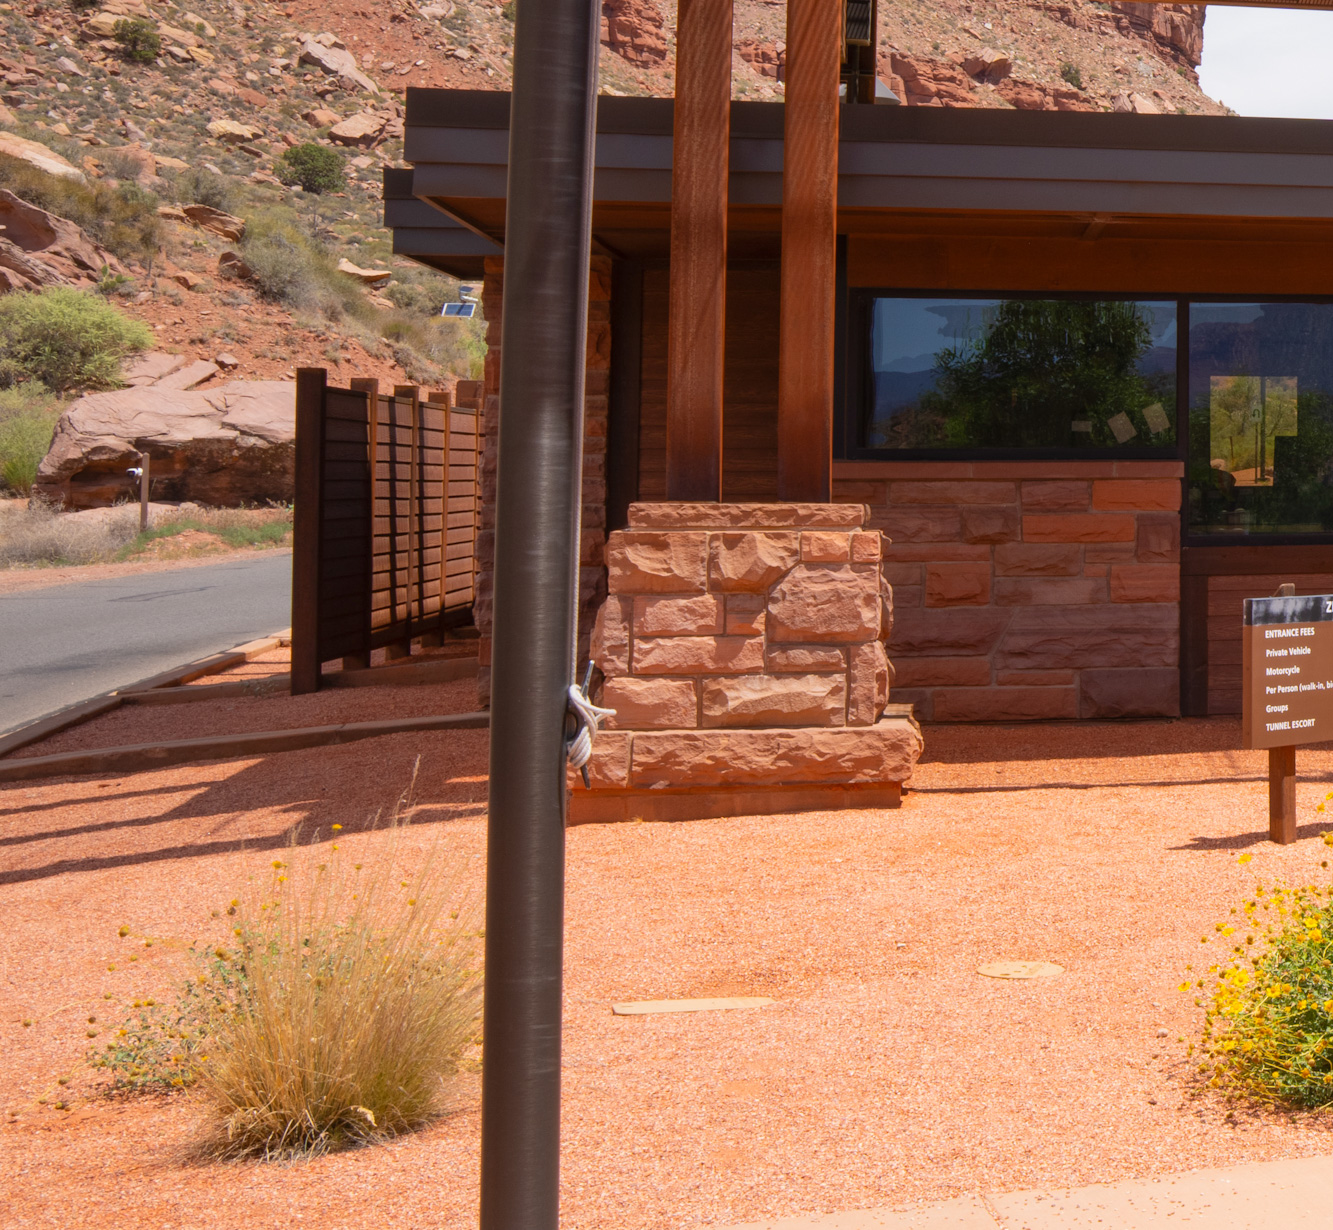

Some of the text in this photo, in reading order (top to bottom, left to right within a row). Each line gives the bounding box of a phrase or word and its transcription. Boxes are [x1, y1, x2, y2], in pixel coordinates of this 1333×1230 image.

[1265, 627, 1315, 639] ENTRANCE FEES
[1266, 646, 1311, 657] Private Vehicle
[1266, 665, 1300, 676] Motorcycle
[1266, 686, 1276, 695] Per
[1277, 684, 1298, 694] Person
[1299, 680, 1326, 693] (walk-in,
[1266, 704, 1289, 714] Groups
[1266, 718, 1316, 731] TUNNEL ESCORT
